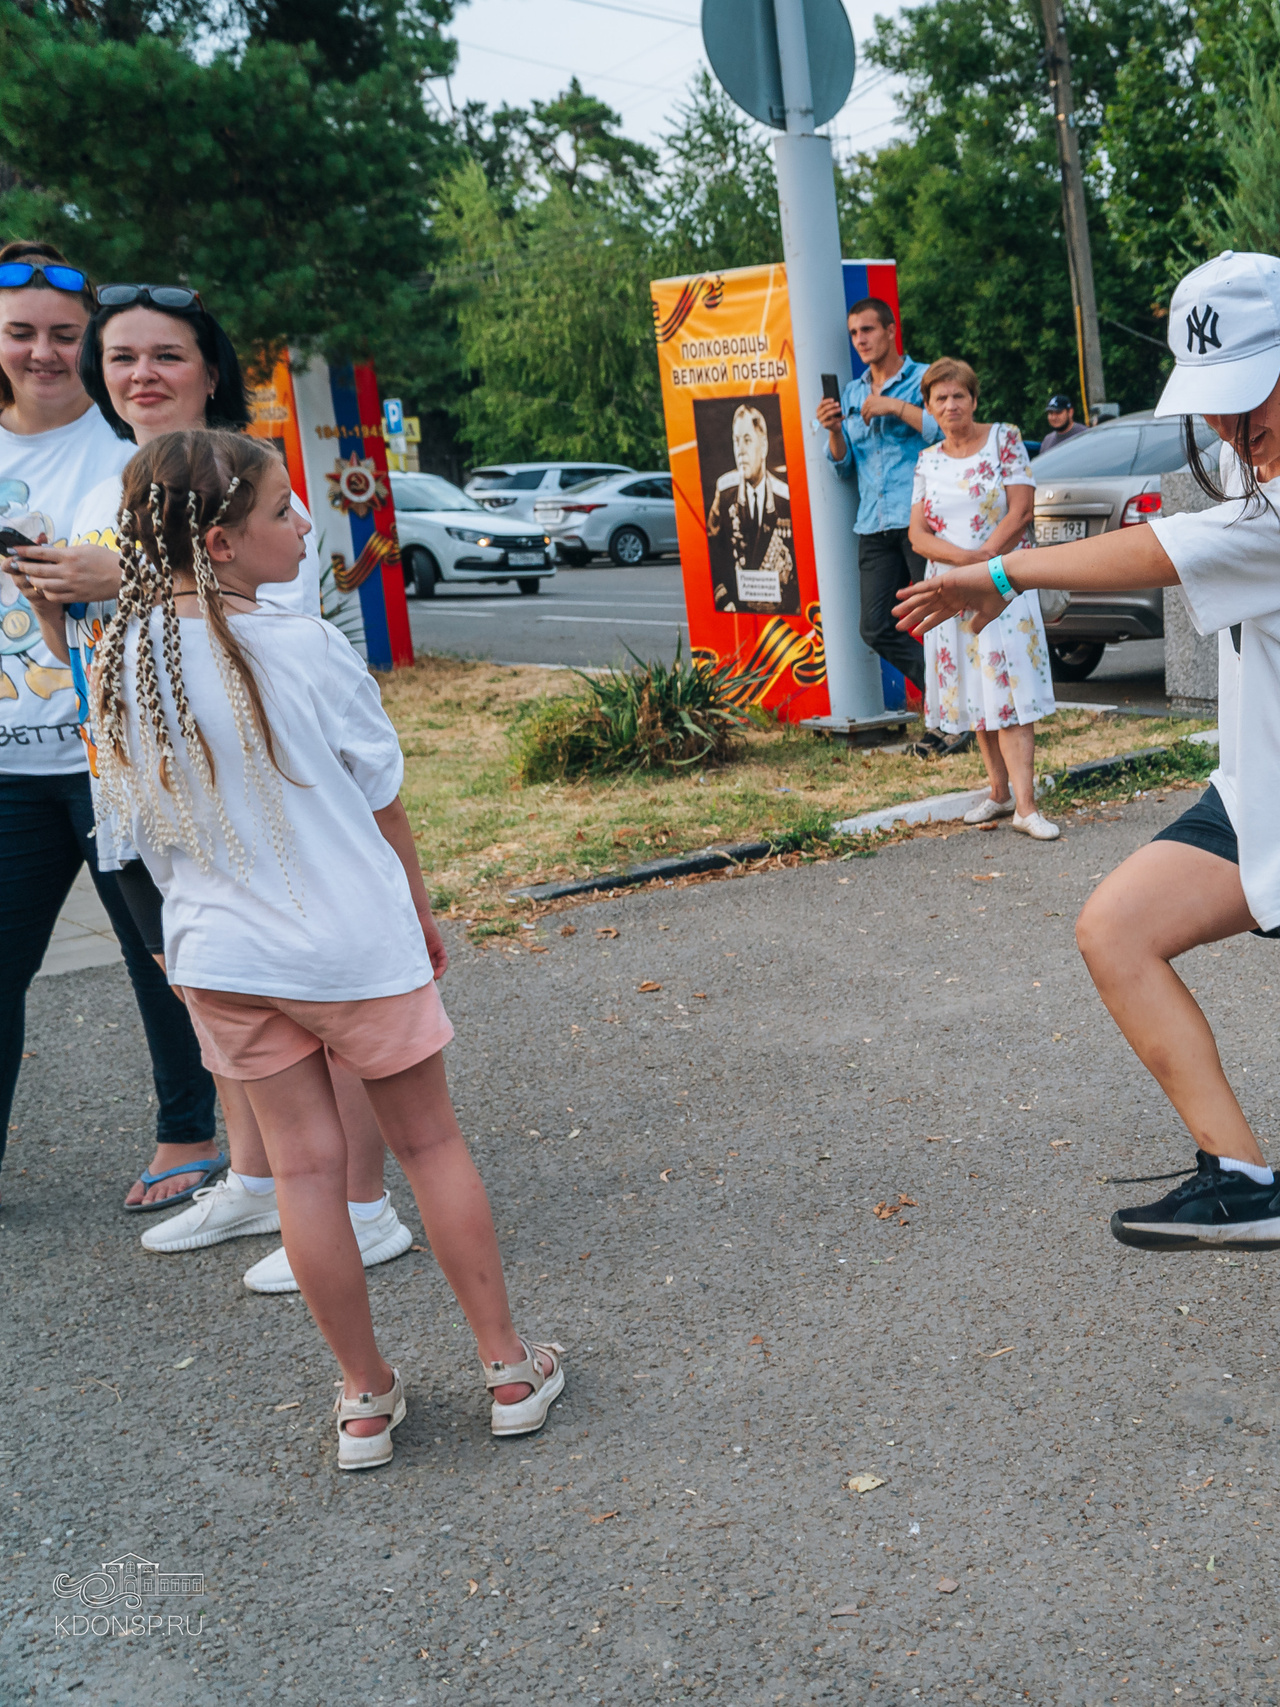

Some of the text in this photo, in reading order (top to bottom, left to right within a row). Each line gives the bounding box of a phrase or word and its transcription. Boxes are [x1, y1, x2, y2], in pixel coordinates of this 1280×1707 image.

[1186, 304, 1222, 355] NY
[681, 334, 769, 360] ПОЛКОВОДЦЫ
[672, 359, 789, 386] ВЕЛИКОЙ ПОБЕДЫ
